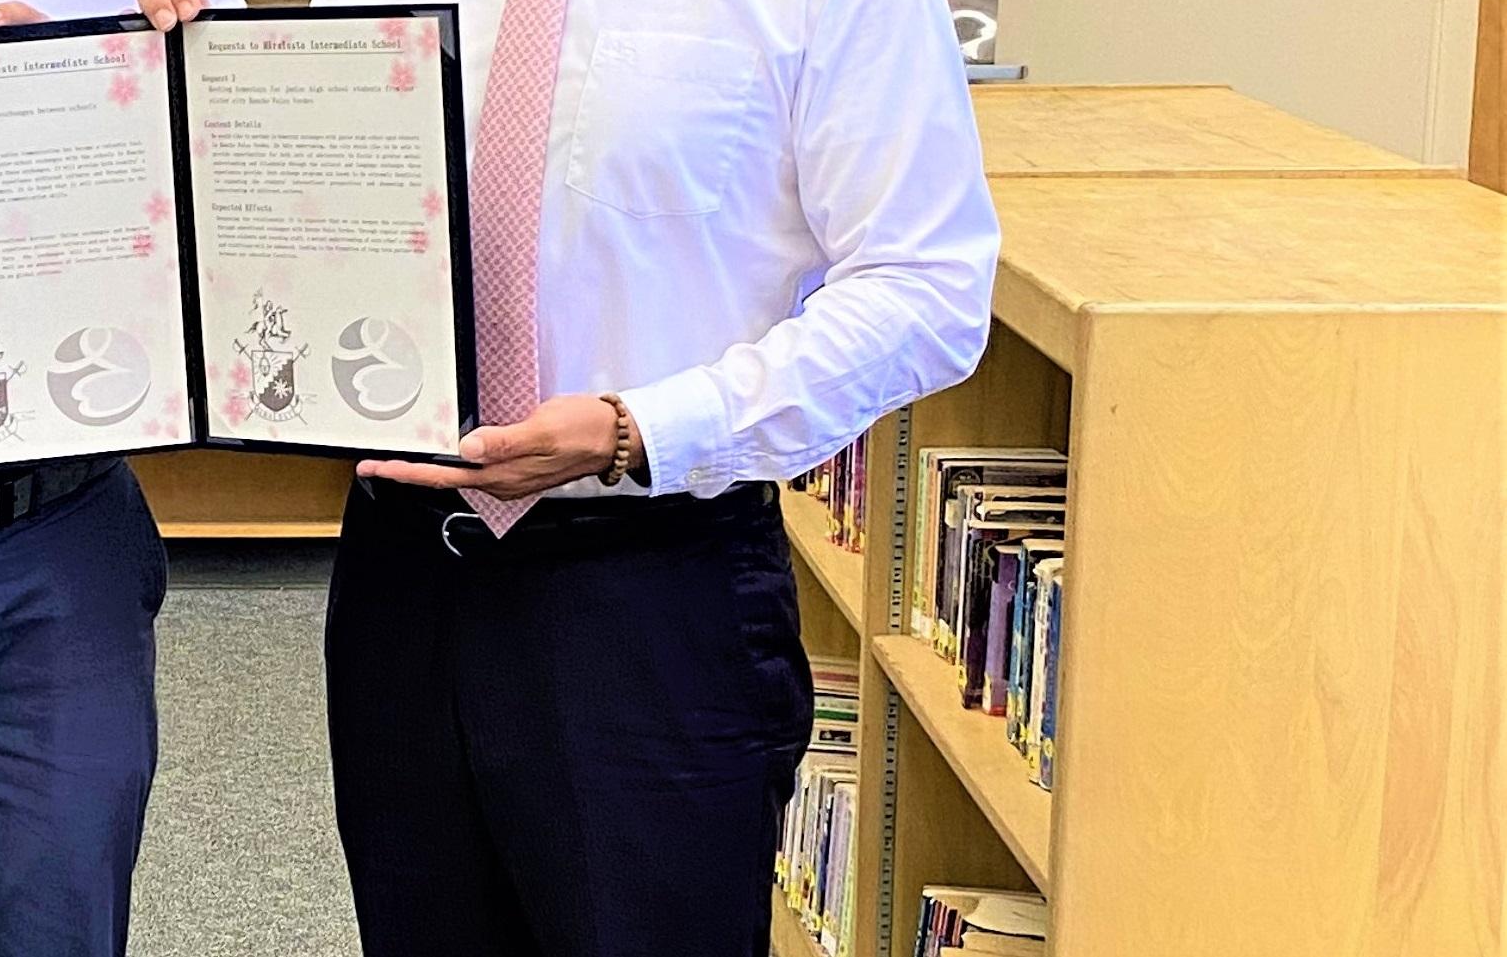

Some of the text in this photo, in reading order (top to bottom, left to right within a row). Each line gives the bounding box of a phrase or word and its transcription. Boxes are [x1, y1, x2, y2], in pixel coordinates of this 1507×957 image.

[208, 42, 246, 52] Requests
[249, 42, 259, 51] to
[23, 58, 89, 72] Intermediate
[93, 53, 127, 65] School
